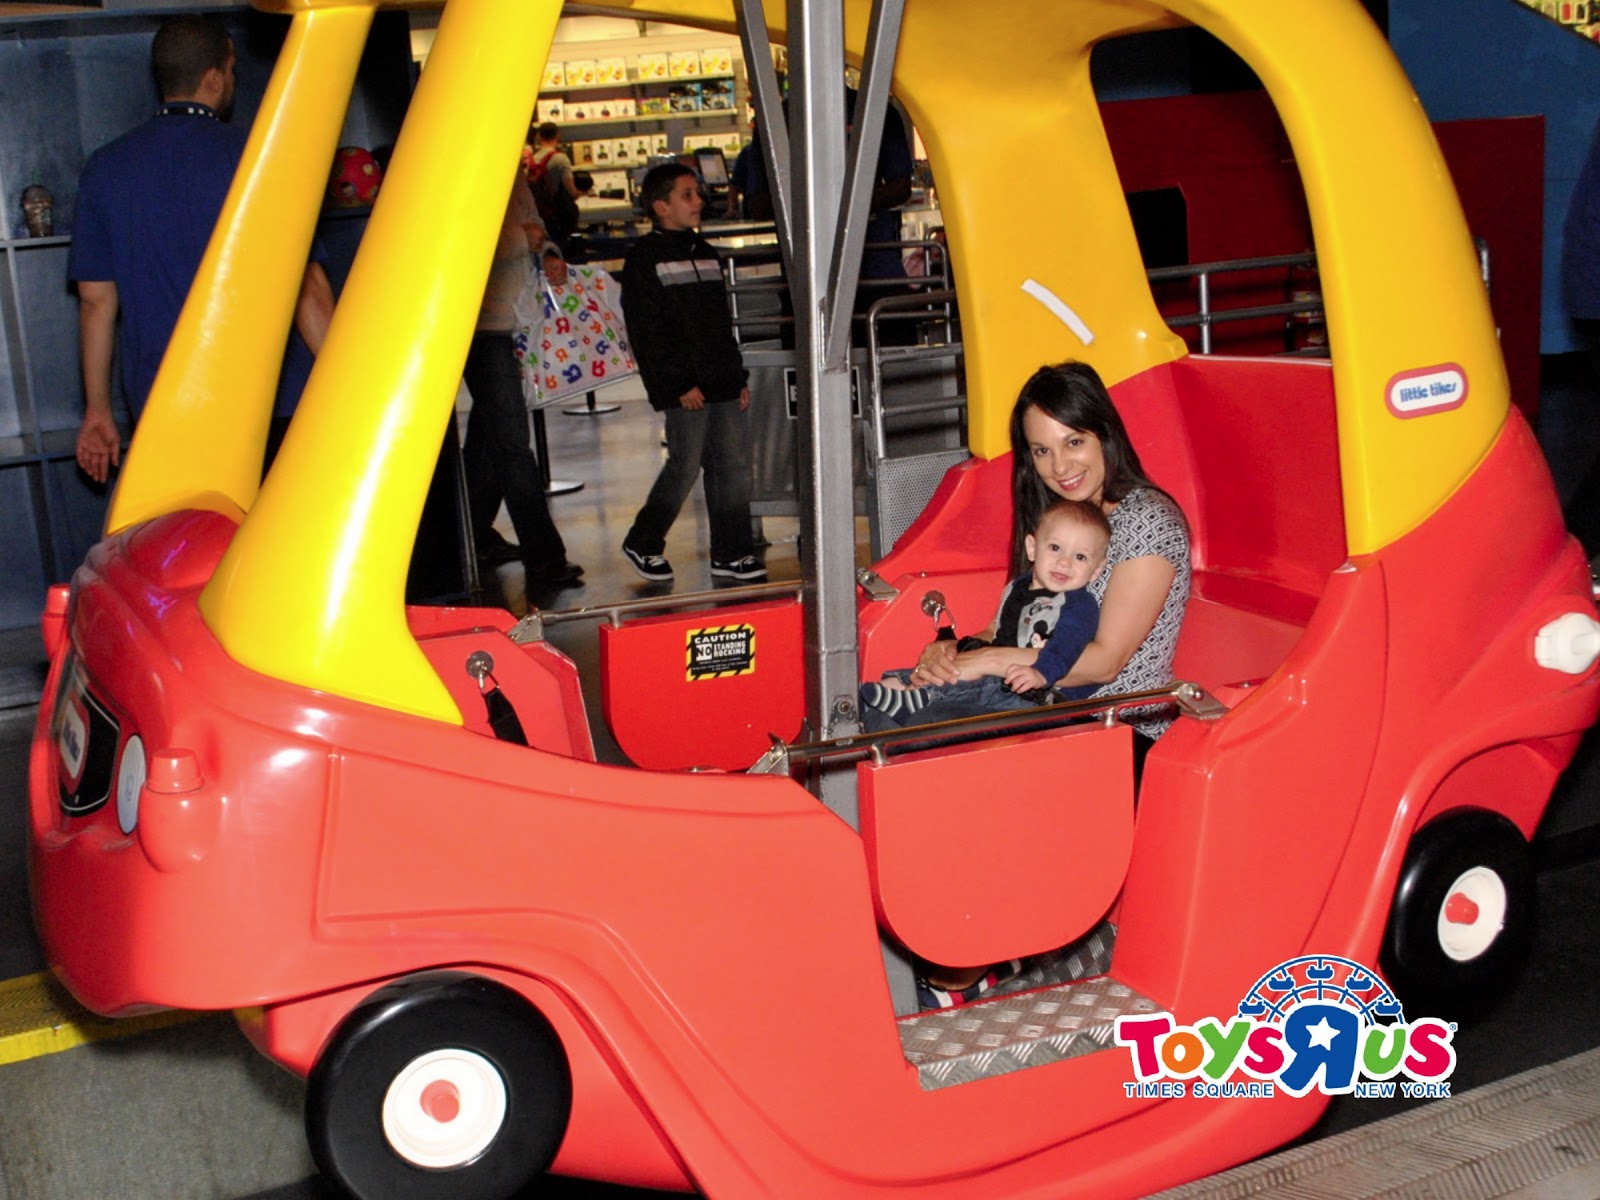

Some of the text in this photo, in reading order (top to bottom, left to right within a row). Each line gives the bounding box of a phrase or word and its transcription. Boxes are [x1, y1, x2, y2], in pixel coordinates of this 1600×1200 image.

[1400, 382, 1456, 402] little tikes
[694, 632, 746, 644] CAUTION
[696, 640, 746, 657] NO STANDING
[713, 646, 746, 658] ROCKING
